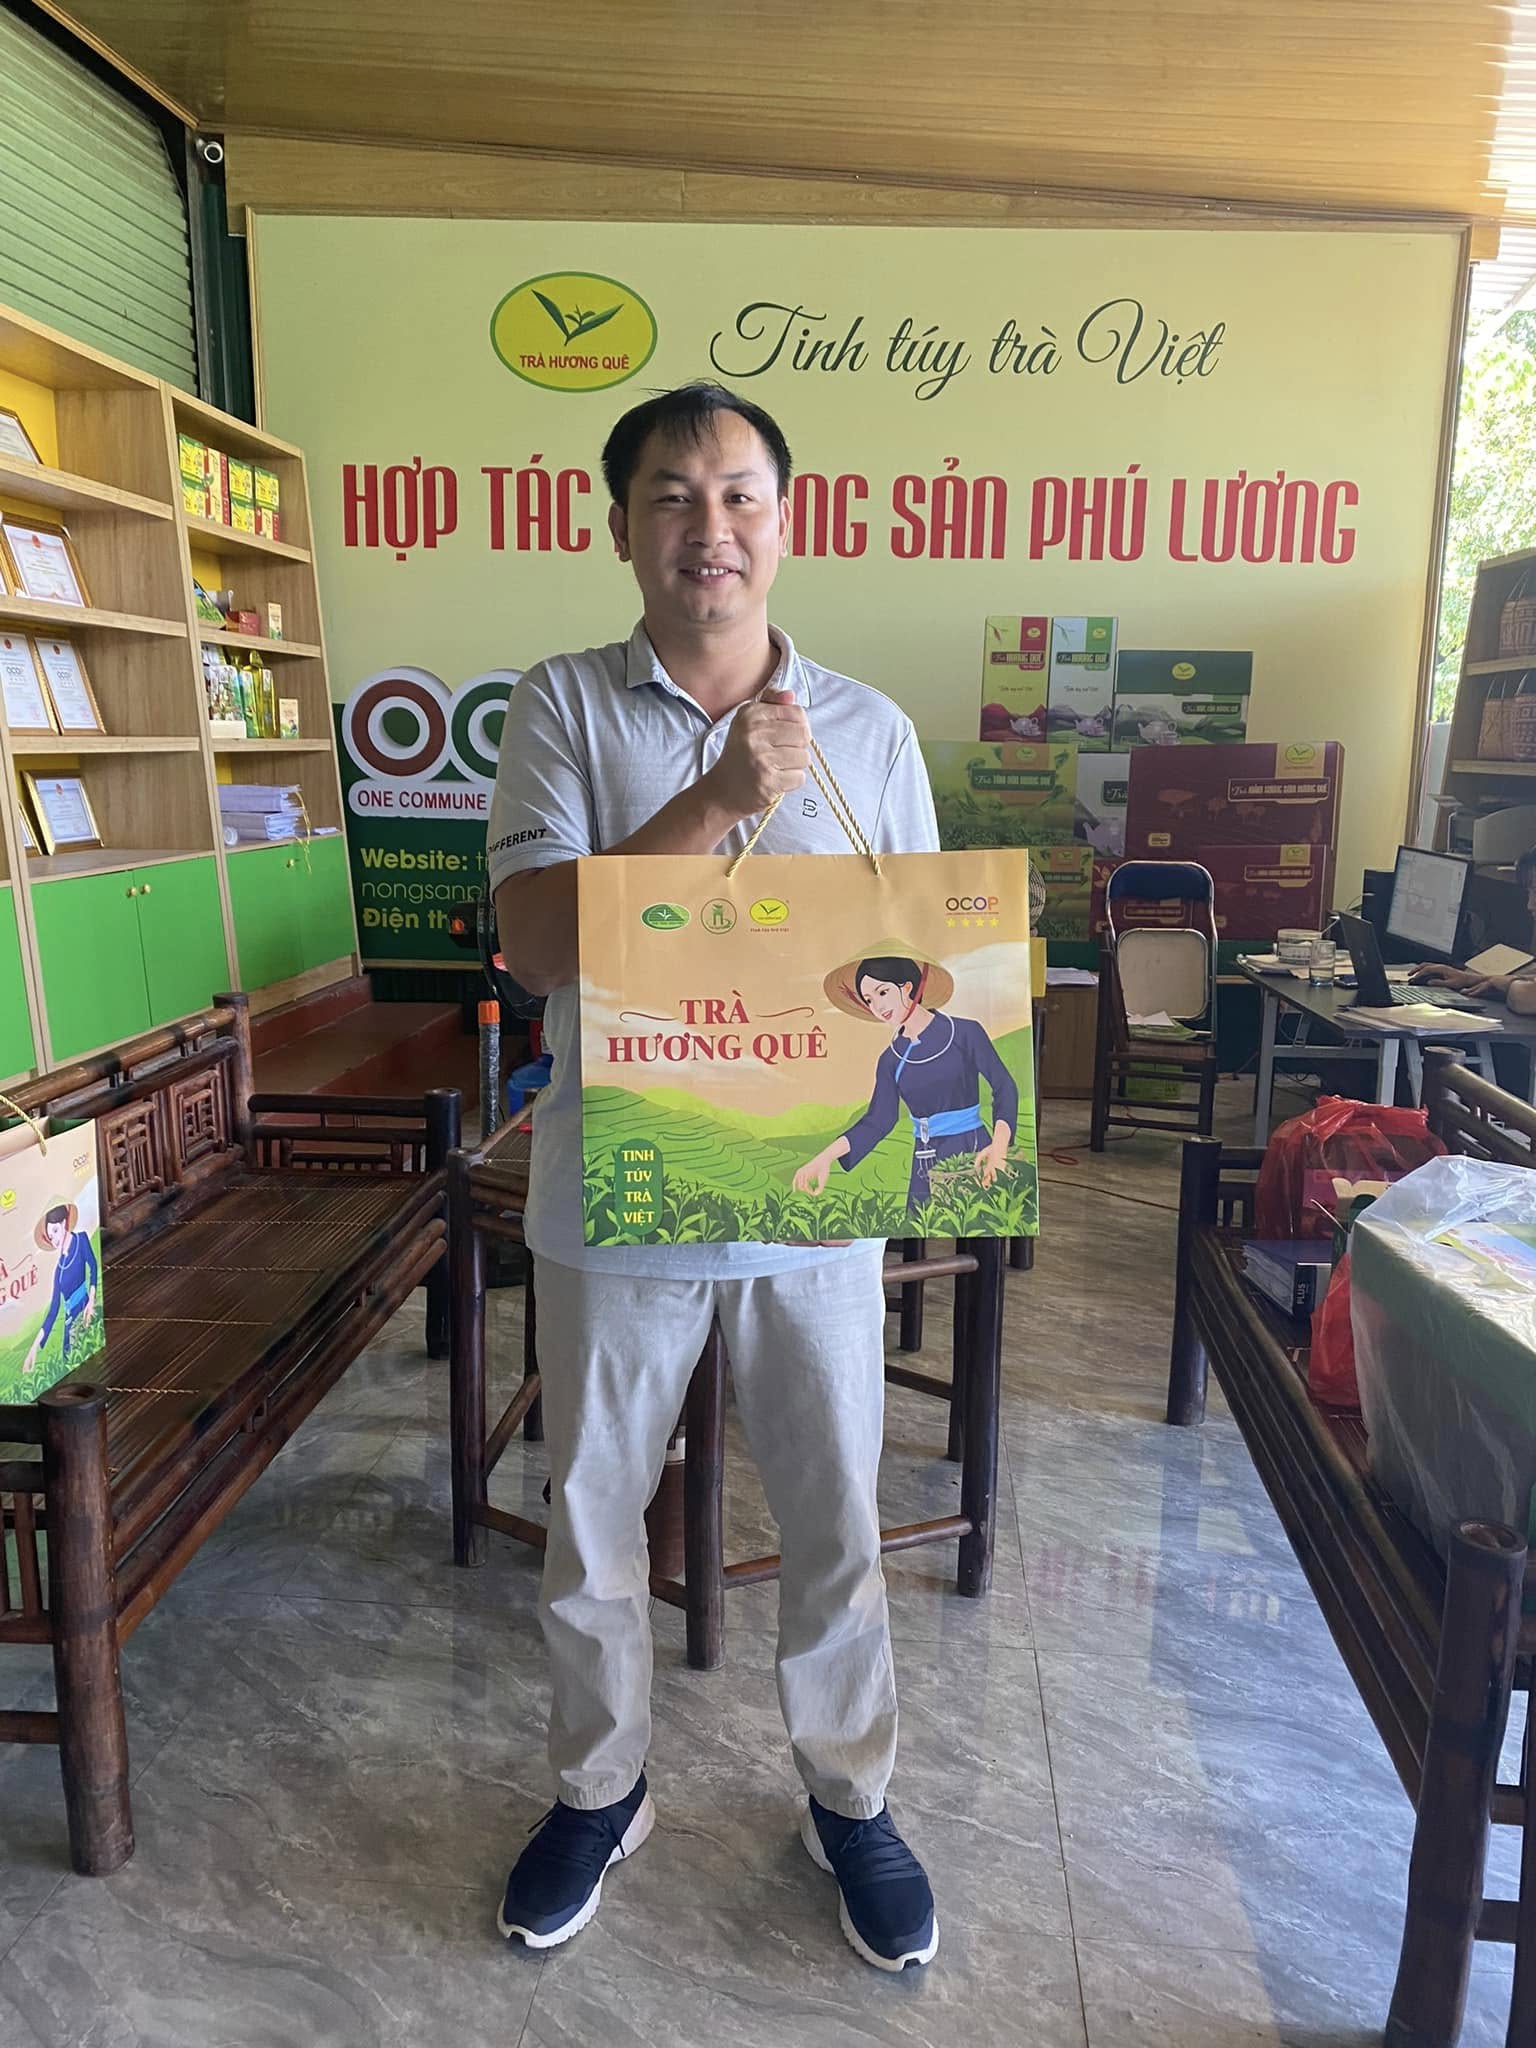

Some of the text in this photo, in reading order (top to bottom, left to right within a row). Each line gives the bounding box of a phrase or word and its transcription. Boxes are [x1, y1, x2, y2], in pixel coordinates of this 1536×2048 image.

[709, 298, 1226, 401] Tinh túy trà Việt
[519, 352, 630, 370] TRÀ HƯƠNG QUÊ
[342, 456, 458, 561] HỢP
[481, 453, 591, 552] TÁC
[890, 457, 1008, 560] SẢN
[1029, 464, 1148, 561] PHÚ
[1168, 470, 1360, 564] LƯƠNG
[357, 790, 488, 810] ONE COMMUNE
[360, 848, 468, 871] Website:
[945, 896, 999, 912] OCOP
[362, 907, 419, 933] Điện
[679, 989, 750, 1025] TRÀ
[606, 1025, 828, 1065] HƯƠNG QUÊ
[622, 1149, 655, 1162] TINH
[624, 1167, 652, 1182] TÚY
[624, 1187, 653, 1203] TRÀ
[623, 1209, 655, 1227] VIỆT
[10, 1264, 38, 1299] QUÊ
